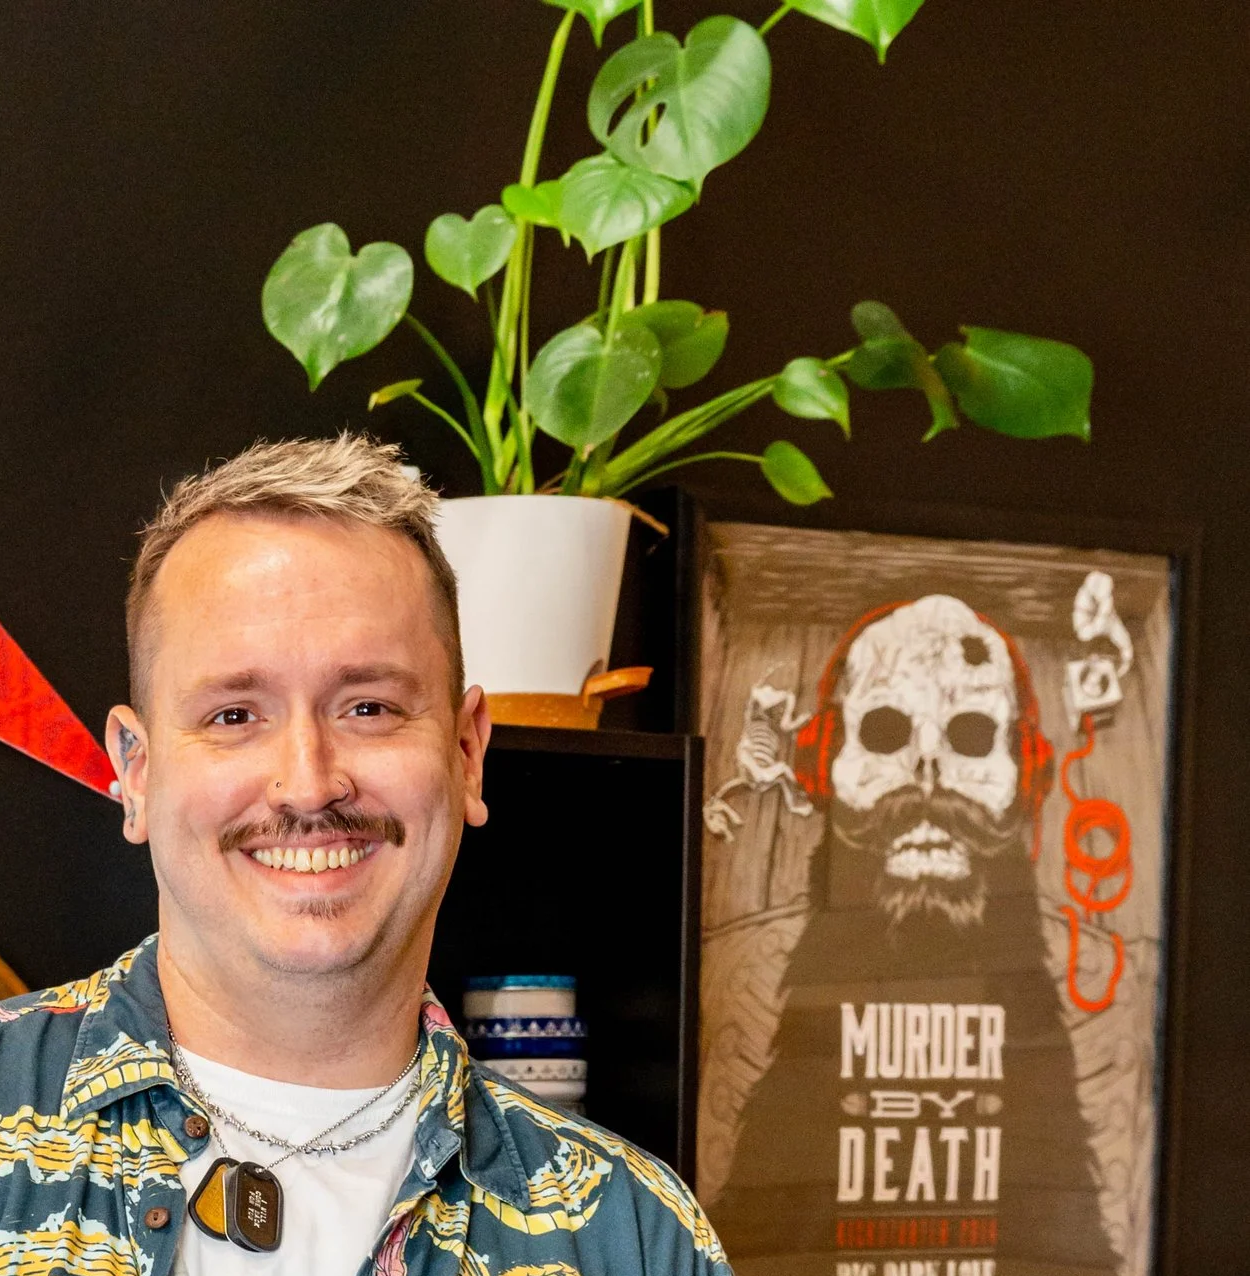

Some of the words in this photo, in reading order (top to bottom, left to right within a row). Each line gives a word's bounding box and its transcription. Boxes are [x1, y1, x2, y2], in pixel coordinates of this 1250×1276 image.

[840, 1003, 1006, 1080] MURDER
[869, 1090, 976, 1119] BY
[836, 1126, 1002, 1202] DEATH
